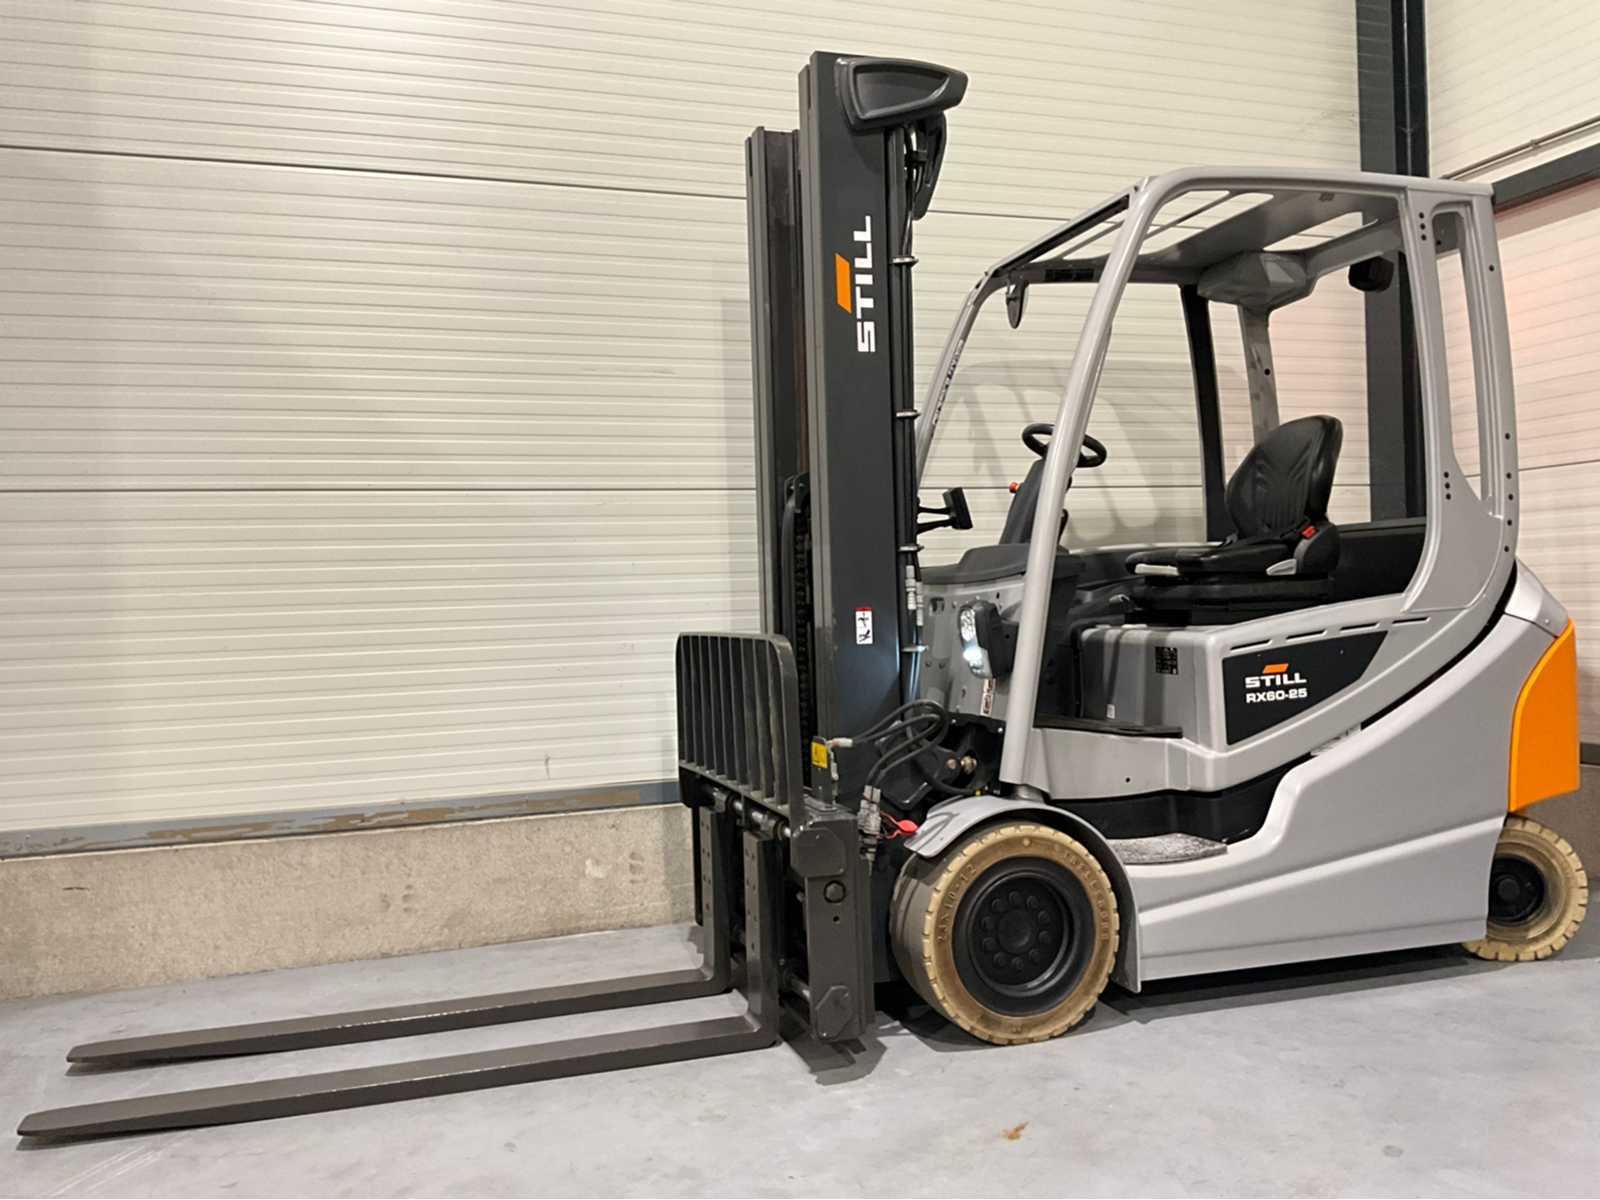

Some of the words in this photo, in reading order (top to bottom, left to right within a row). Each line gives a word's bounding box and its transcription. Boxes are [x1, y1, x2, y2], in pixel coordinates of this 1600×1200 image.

[853, 215, 876, 352] STILL
[1244, 672, 1307, 688] STILL
[1246, 688, 1308, 703] RX60-25
